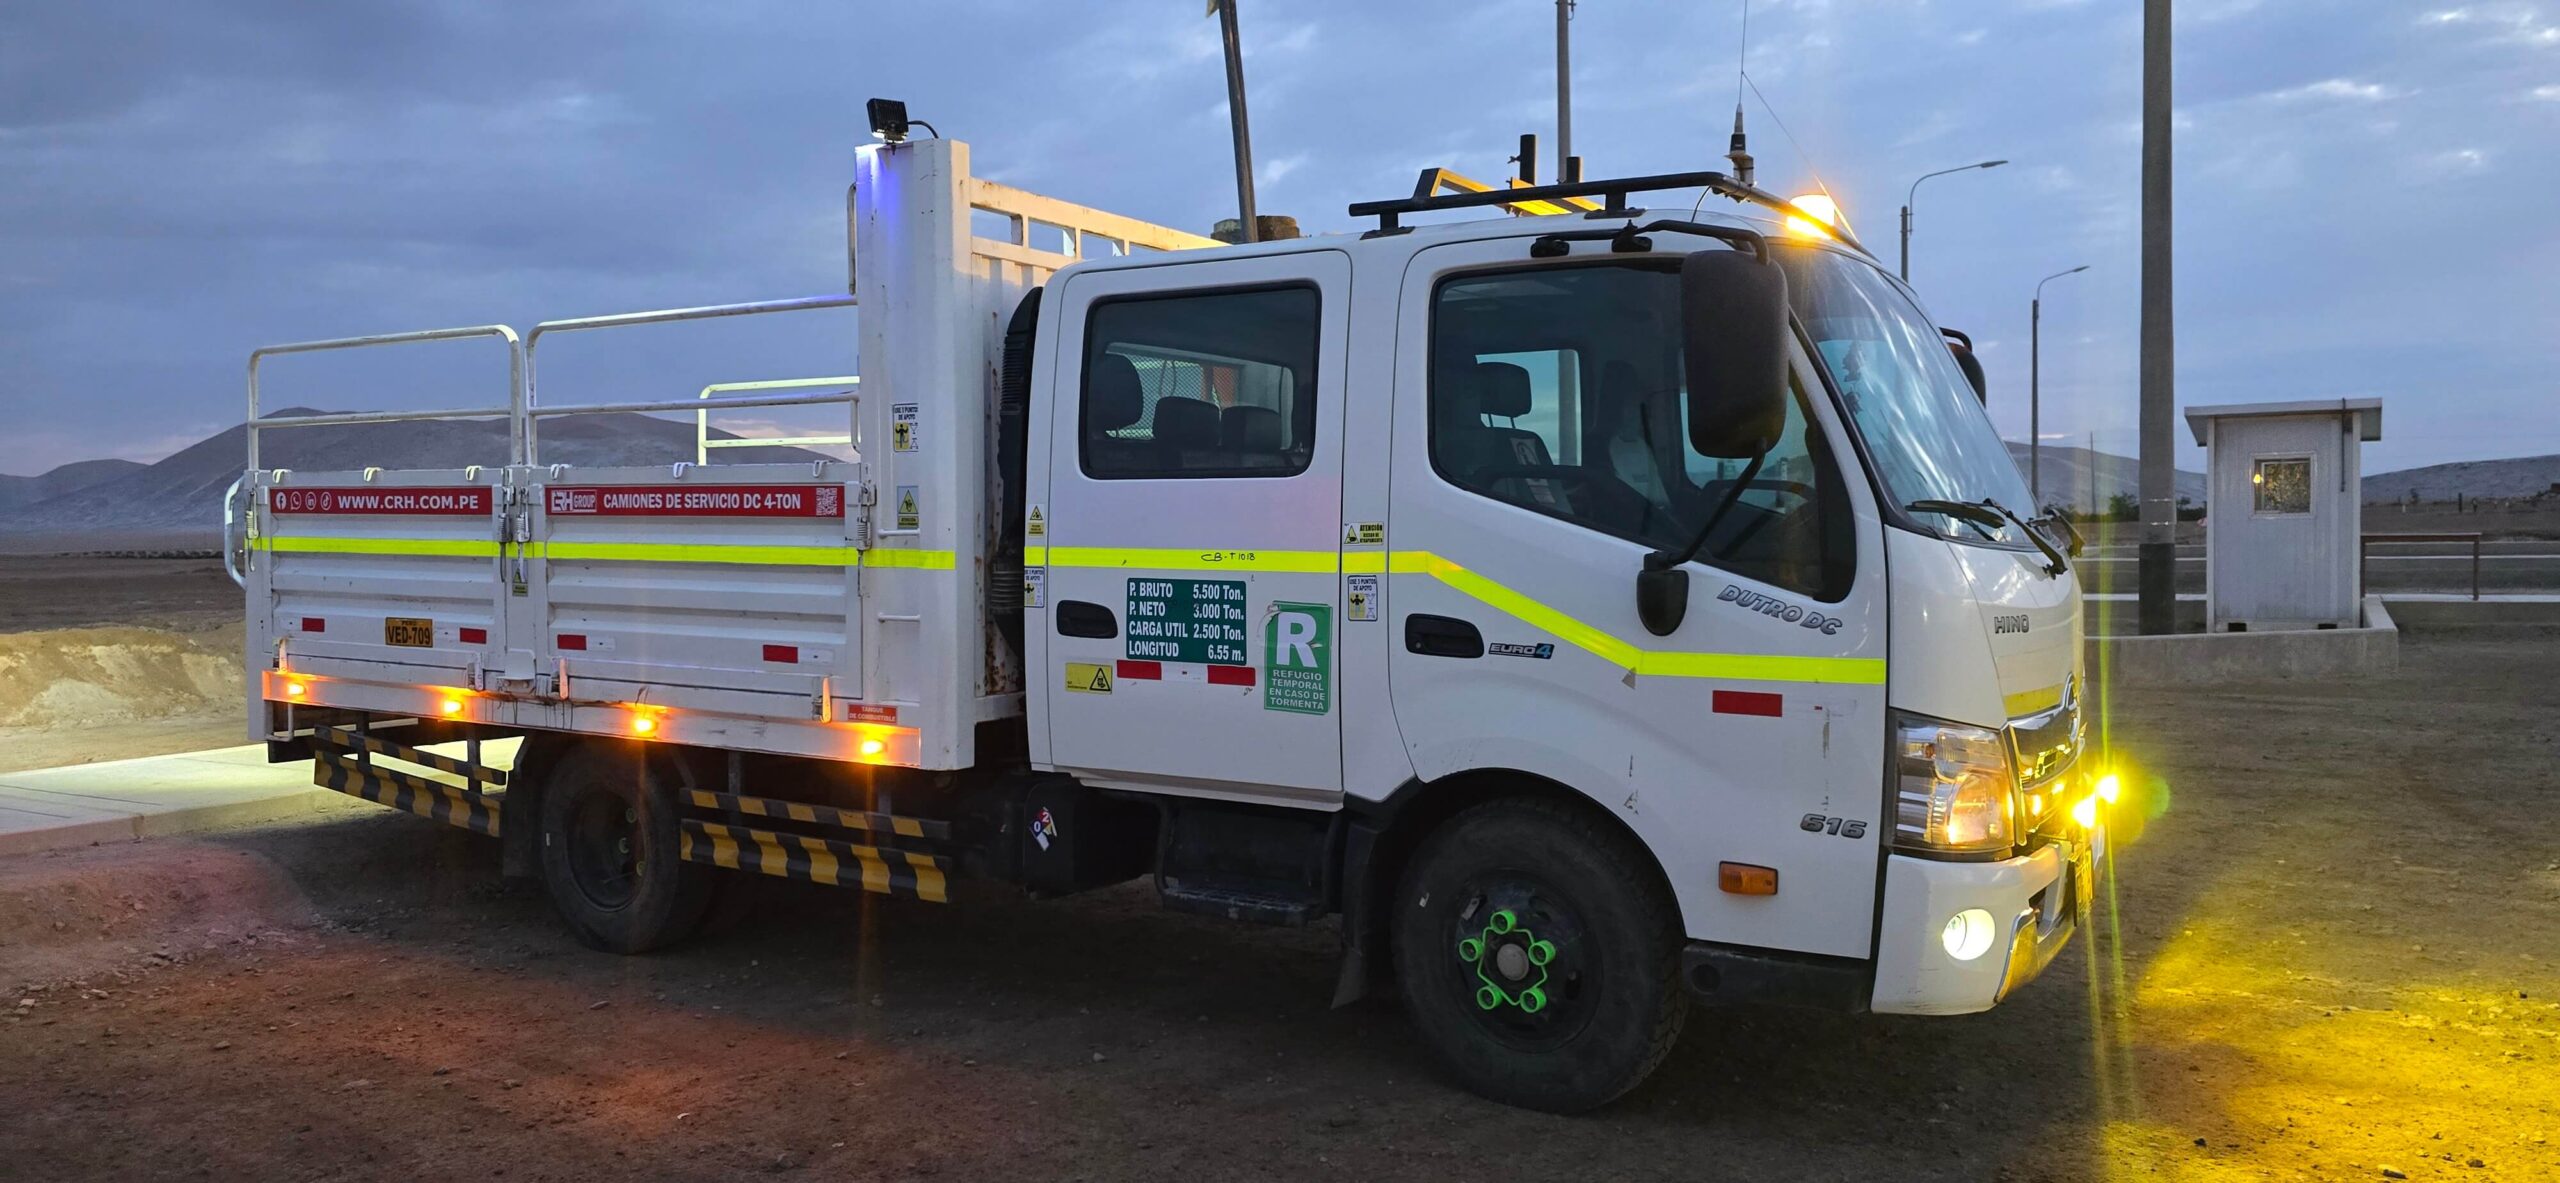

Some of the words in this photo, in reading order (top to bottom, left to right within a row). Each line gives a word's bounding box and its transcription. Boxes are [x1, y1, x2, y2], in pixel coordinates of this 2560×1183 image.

[337, 495, 479, 510] WWW.CRH.COM.PE
[573, 494, 596, 509] GROUP
[603, 493, 663, 510] CAMIONES
[665, 494, 682, 509] DE
[684, 493, 740, 510] SERVICIO
[743, 494, 761, 510] DC
[764, 494, 801, 510] 4-TON
[1129, 582, 1137, 597] P.
[1139, 582, 1174, 598] BRUTO
[1192, 584, 1220, 600] 5.500
[1222, 585, 1245, 601] Ton.
[1129, 601, 1137, 616] P.
[1139, 602, 1166, 617] NETO
[1192, 604, 1221, 619] 3.000
[1222, 604, 1245, 621] Ton.
[1716, 584, 1803, 622] DUTRO
[1799, 611, 1844, 636] DC
[1128, 620, 1163, 637] CARGA
[1164, 622, 1189, 638] UTIL
[1192, 624, 1221, 640] 2.500
[1222, 625, 1245, 641] Ton.
[1993, 614, 2030, 634] HINO
[1276, 611, 1318, 668] R
[1128, 640, 1180, 657] LONGITUD
[1207, 644, 1229, 660] 6.55
[1231, 648, 1245, 662] m.
[1273, 669, 1322, 681] REFUGIO
[1272, 679, 1324, 691] TEMPORAL
[1269, 687, 1282, 696] EN
[1284, 689, 1310, 699] CASO
[1312, 692, 1326, 701] DE
[1270, 697, 1324, 710] TORMENTA
[1042, 811, 1049, 823] 2
[1033, 821, 1041, 832] 0
[1800, 813, 1867, 839] 616
